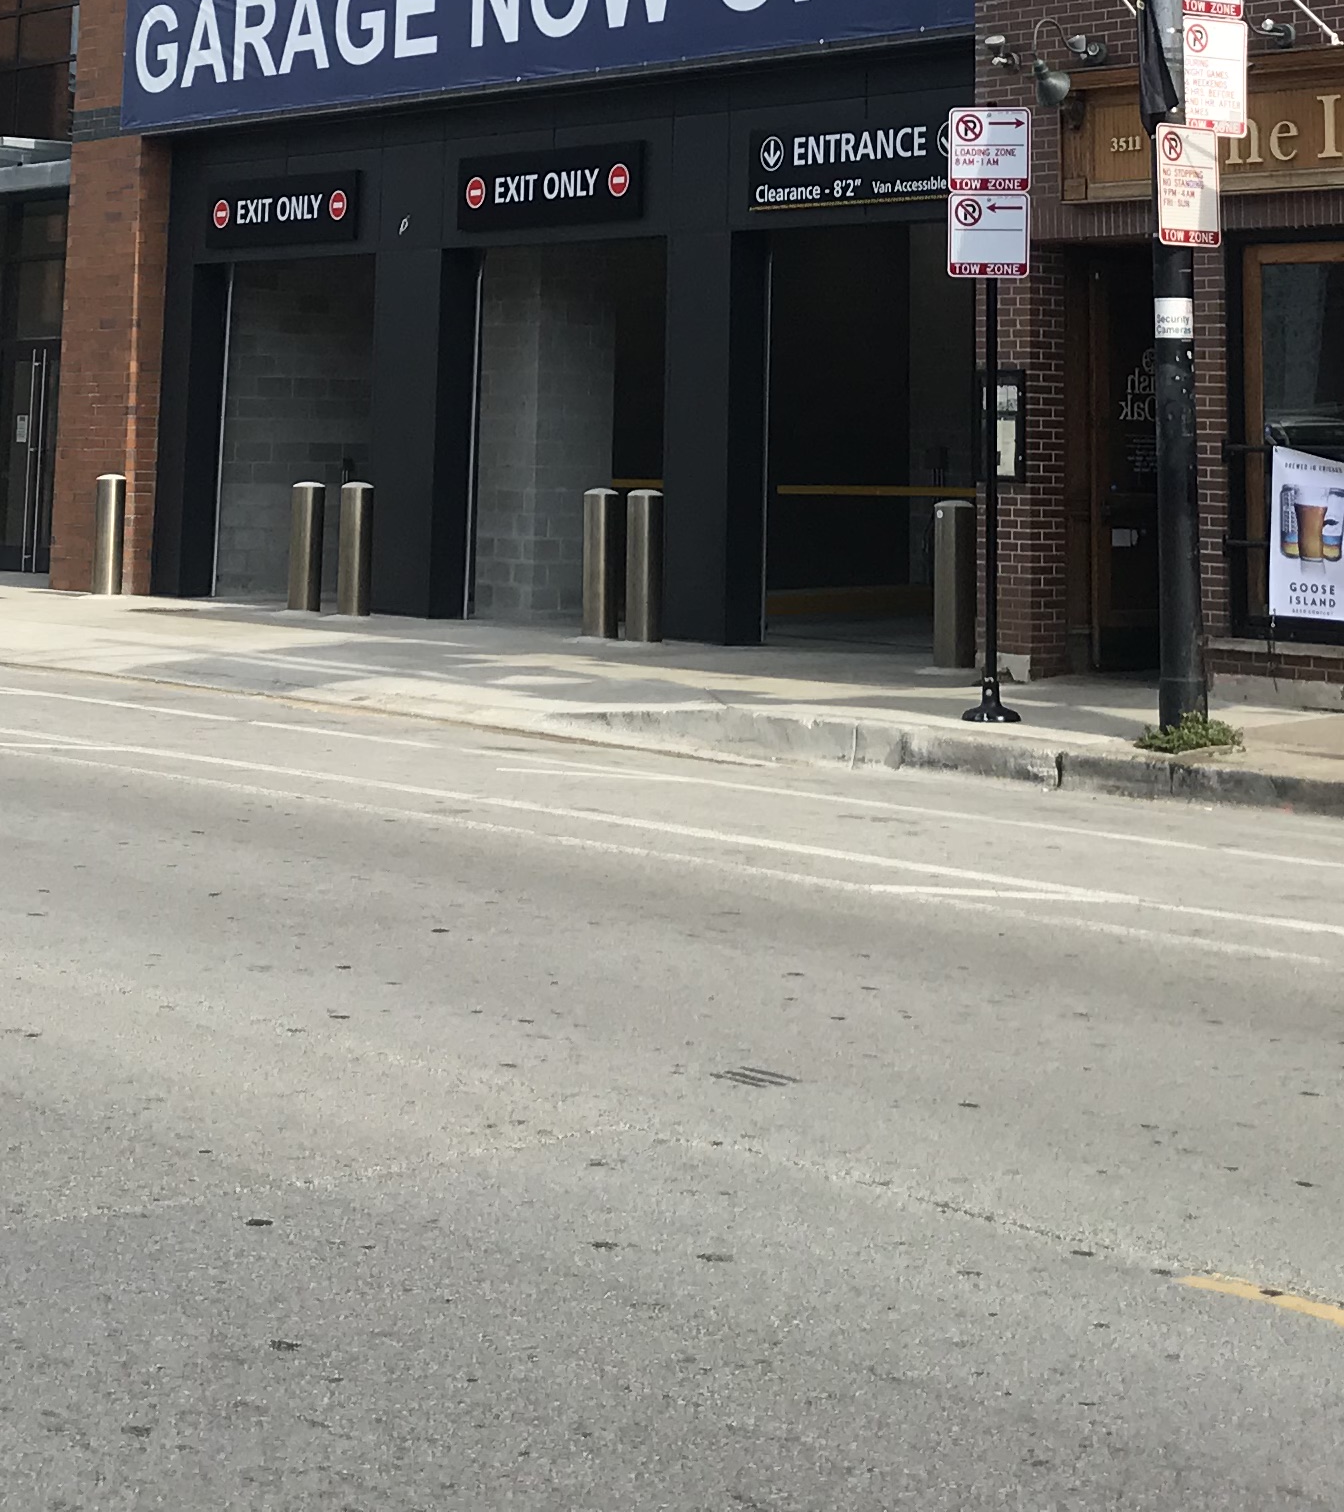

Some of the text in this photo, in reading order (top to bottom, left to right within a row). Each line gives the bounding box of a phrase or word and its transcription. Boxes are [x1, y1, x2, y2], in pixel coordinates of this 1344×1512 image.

[1184, 0, 1236, 15] TOW ZONE
[793, 126, 927, 166] ENTRANCE
[1110, 135, 1141, 153] 3511
[955, 148, 1017, 157] LOADING ZONE
[1162, 168, 1204, 179] NO STOPPING
[494, 167, 601, 205] EXIT ONLY
[756, 184, 821, 203] Clearance
[872, 180, 892, 194] Van
[893, 175, 947, 193] Accessible
[955, 179, 1022, 190] TOW ZONE
[1162, 178, 1171, 187] NO
[236, 193, 323, 224] EXIT ONLY
[1164, 229, 1215, 244] TOW ZONE
[954, 264, 1021, 275] TOW ZONE
[1156, 313, 1190, 326] Security
[1156, 324, 1191, 335] Cameras
[1289, 582, 1336, 596] GOOSE
[1289, 595, 1337, 608] ISLAND
